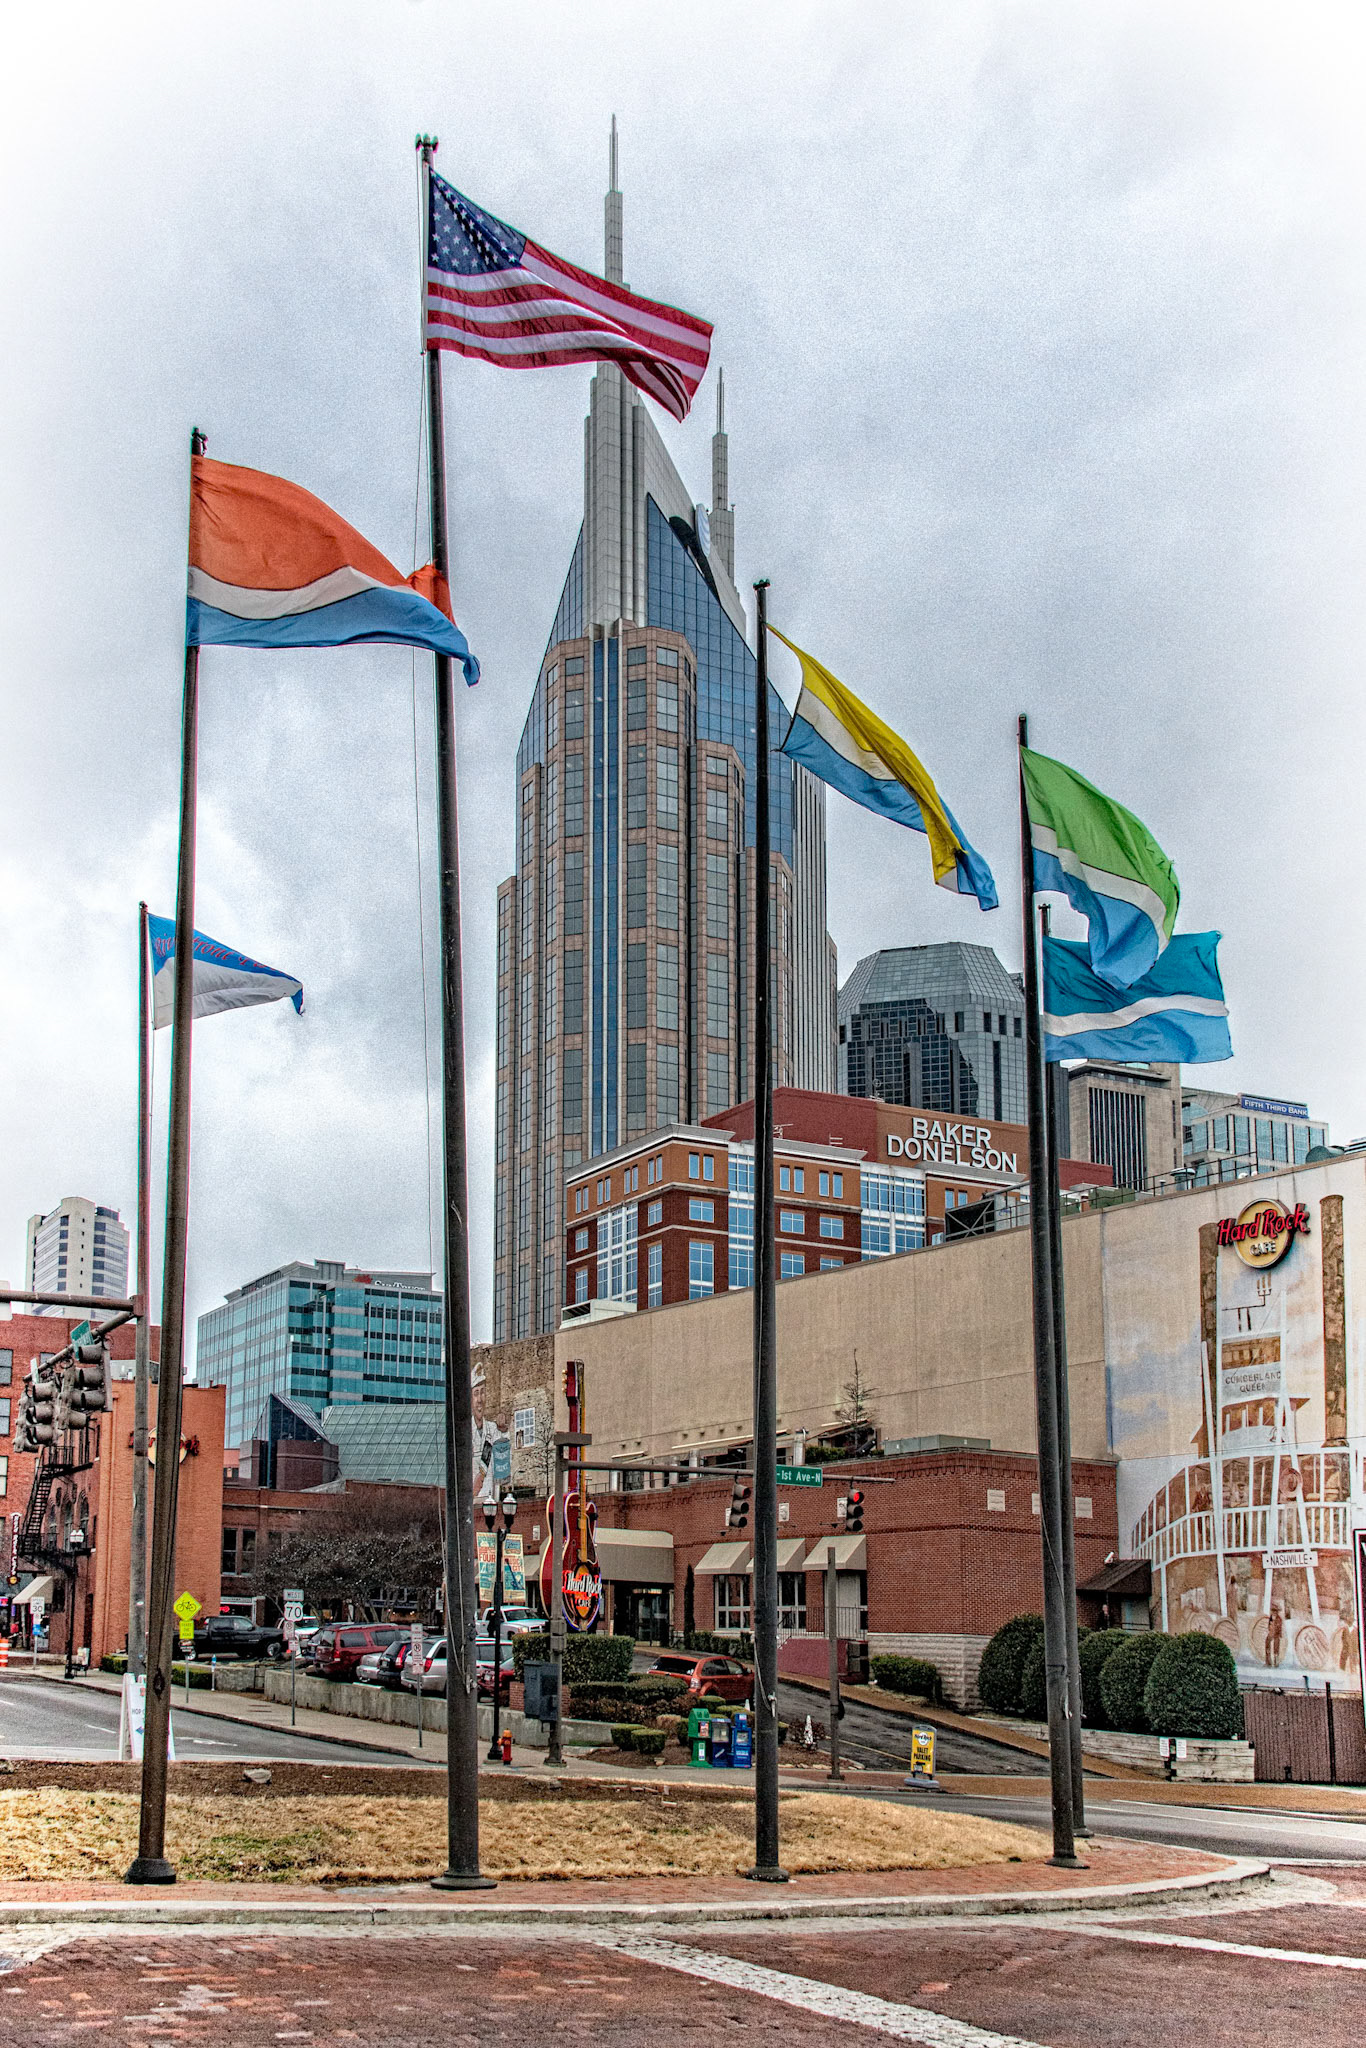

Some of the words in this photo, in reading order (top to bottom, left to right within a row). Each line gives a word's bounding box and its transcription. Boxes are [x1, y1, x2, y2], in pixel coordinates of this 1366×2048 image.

[1244, 1099, 1264, 1108] FIFTH
[1265, 1102, 1287, 1112] THIRD
[1288, 1106, 1308, 1116] BANK
[912, 1117, 992, 1149] BAKER
[887, 1134, 1017, 1173] DONELSON
[1217, 1212, 1262, 1246] Hard
[1262, 1203, 1310, 1238] Rock
[1250, 1240, 1276, 1256] CAFE
[1225, 1371, 1281, 1384] CUMBERLAND
[479, 1554, 496, 1563] FOUR
[1270, 1554, 1308, 1566] NASHVILLE
[32, 1605, 43, 1613] 30
[286, 1606, 302, 1618] 70
